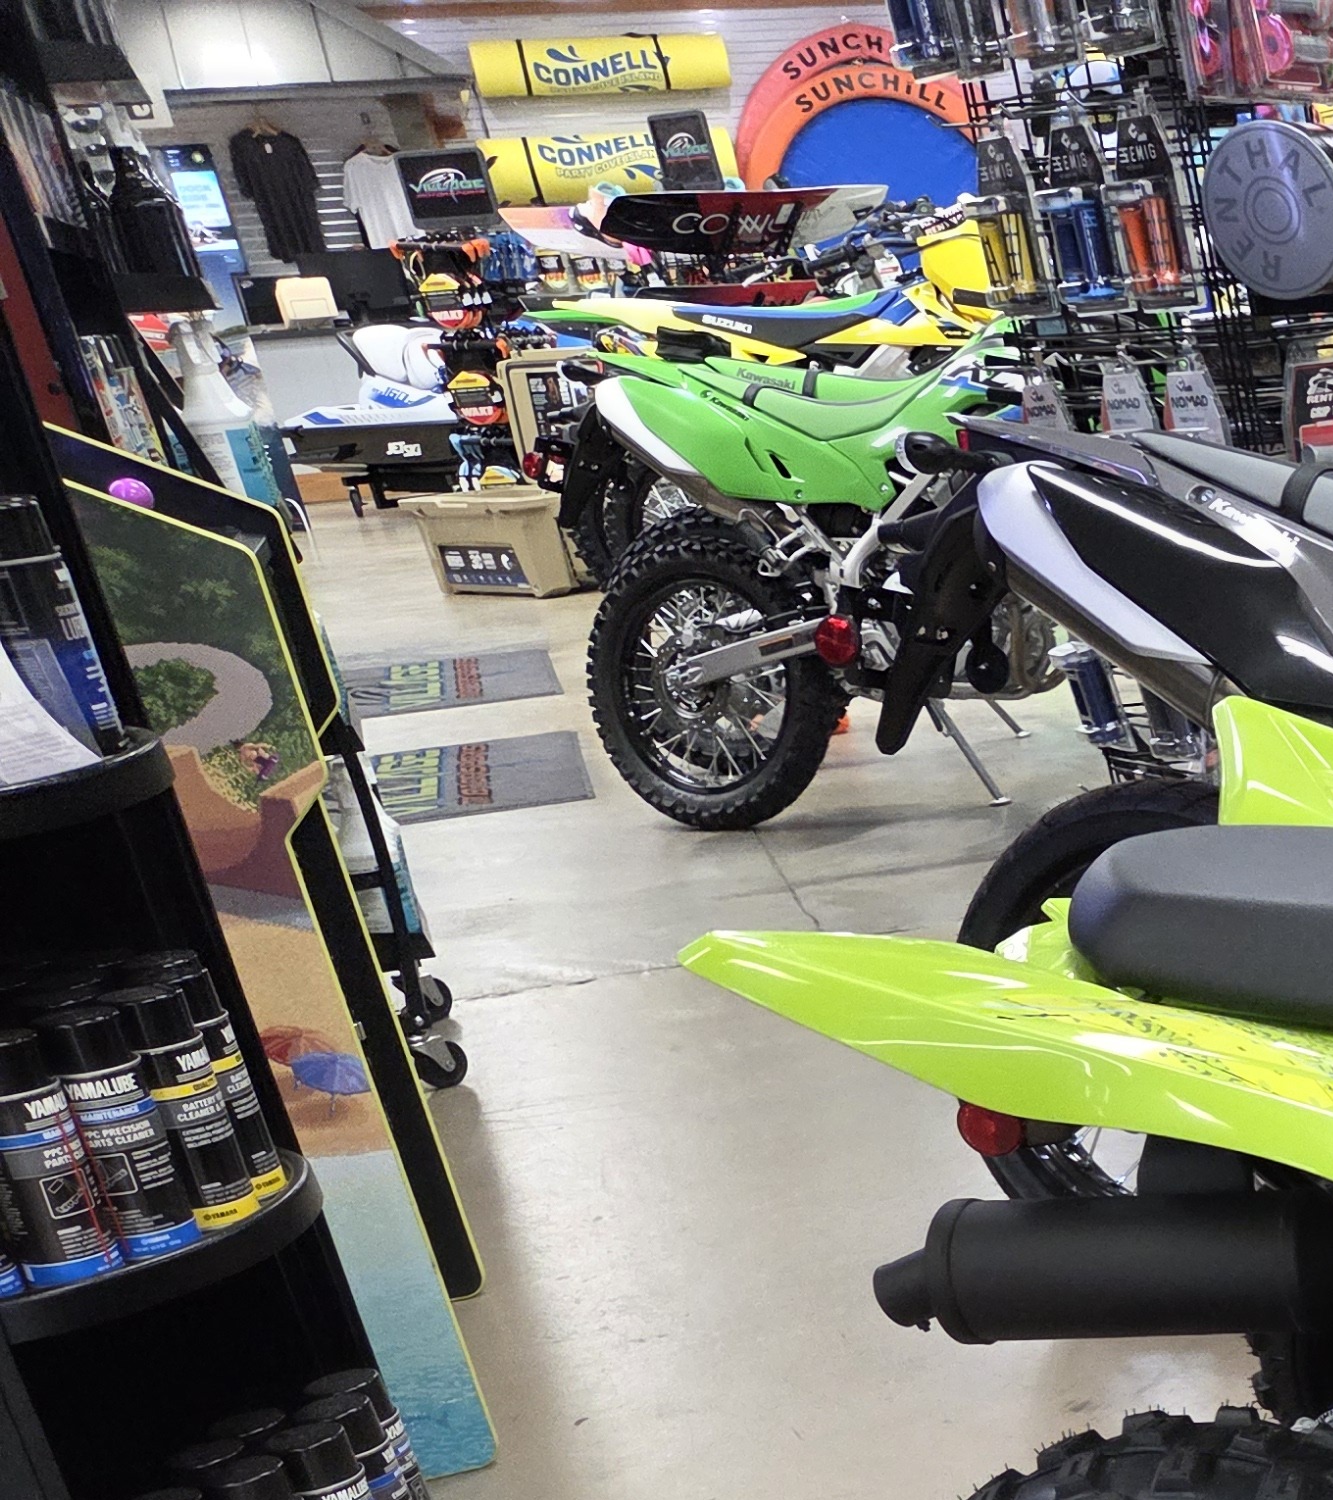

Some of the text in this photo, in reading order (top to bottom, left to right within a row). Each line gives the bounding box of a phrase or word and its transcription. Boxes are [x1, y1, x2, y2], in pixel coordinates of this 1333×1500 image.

[782, 33, 885, 80] SUNCH
[538, 133, 656, 167] CONNELL
[623, 150, 656, 164] ISLAN
[701, 314, 753, 334] SUZUKI
[736, 367, 796, 391] Kawasaki
[1310, 404, 1331, 419] GRIP
[176, 1045, 211, 1072] YAMA
[64, 1072, 139, 1101] YAMALUBE
[101, 1120, 151, 1138] PRECISION
[115, 1128, 156, 1145] CLEANER
